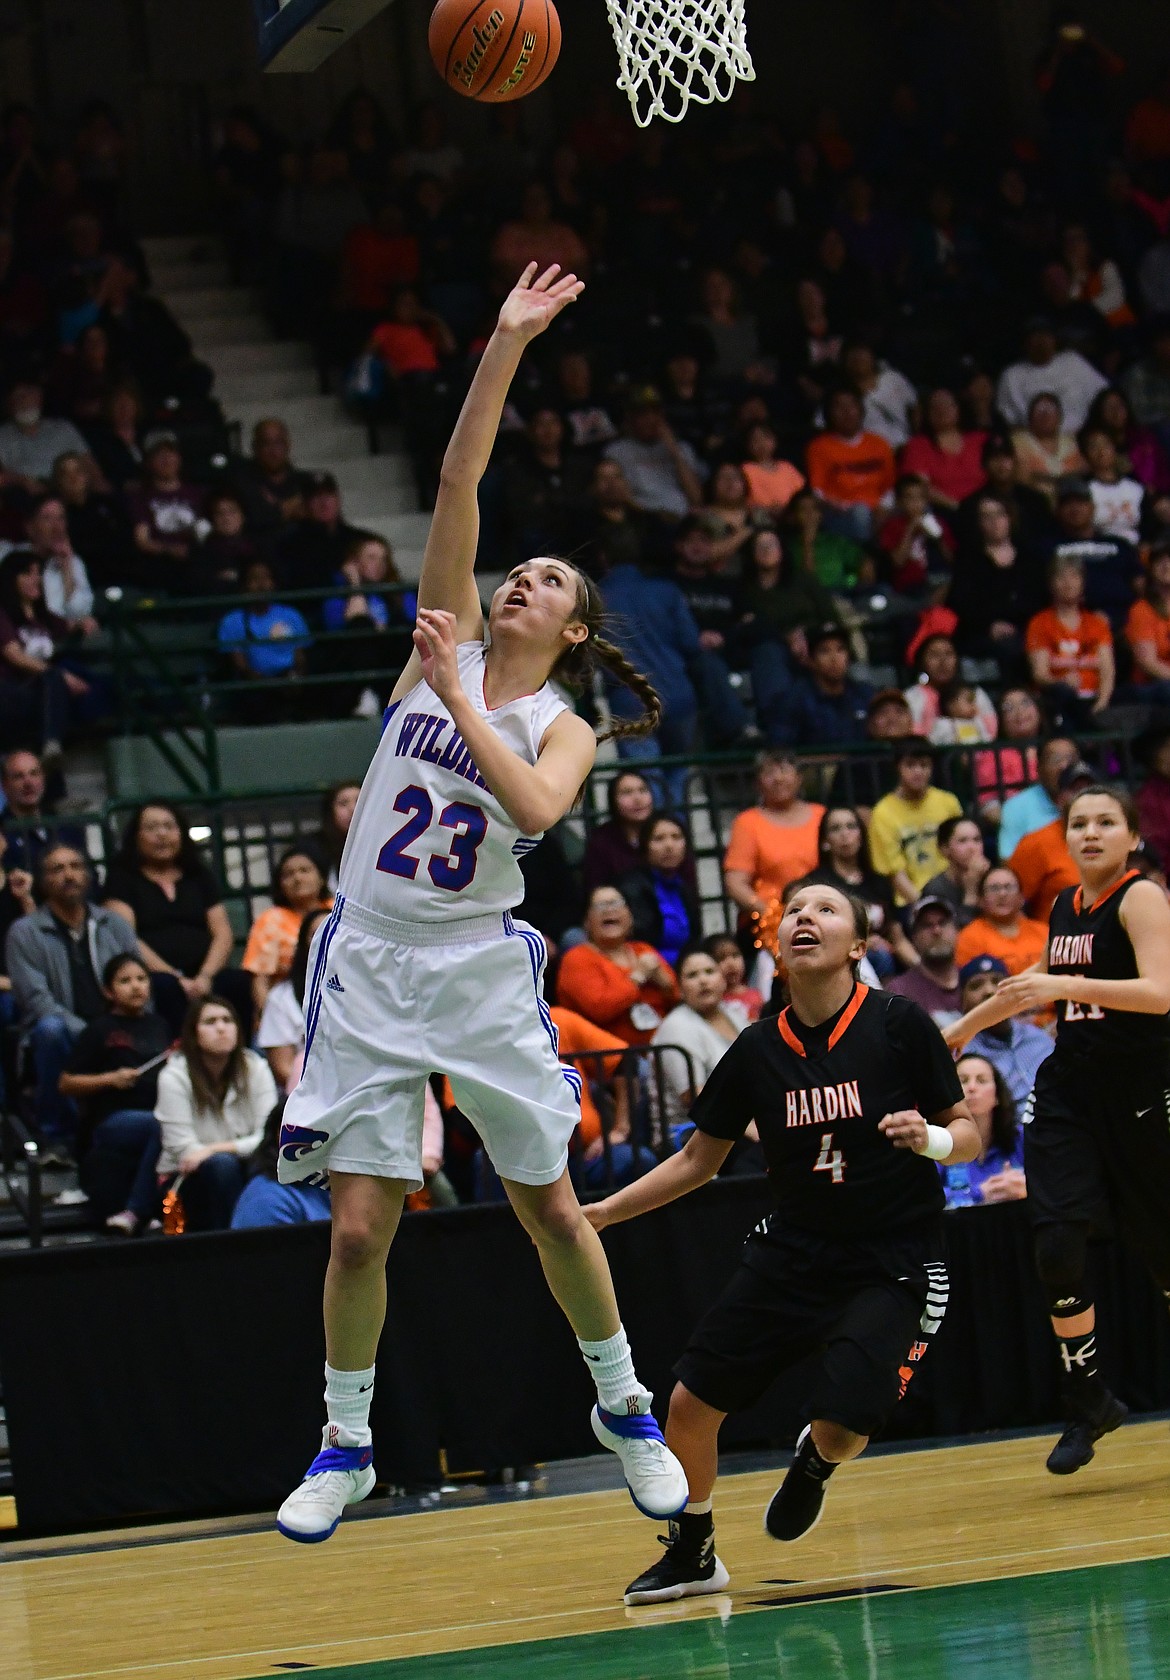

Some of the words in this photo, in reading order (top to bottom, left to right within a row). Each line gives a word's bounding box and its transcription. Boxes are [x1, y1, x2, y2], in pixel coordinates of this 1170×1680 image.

[453, 9, 505, 89] Baden
[495, 31, 537, 95] ELITE
[376, 784, 488, 892] 23
[1050, 934, 1095, 966] HARDIN
[785, 1080, 863, 1128] HARDIN
[813, 1133, 847, 1183] 4
